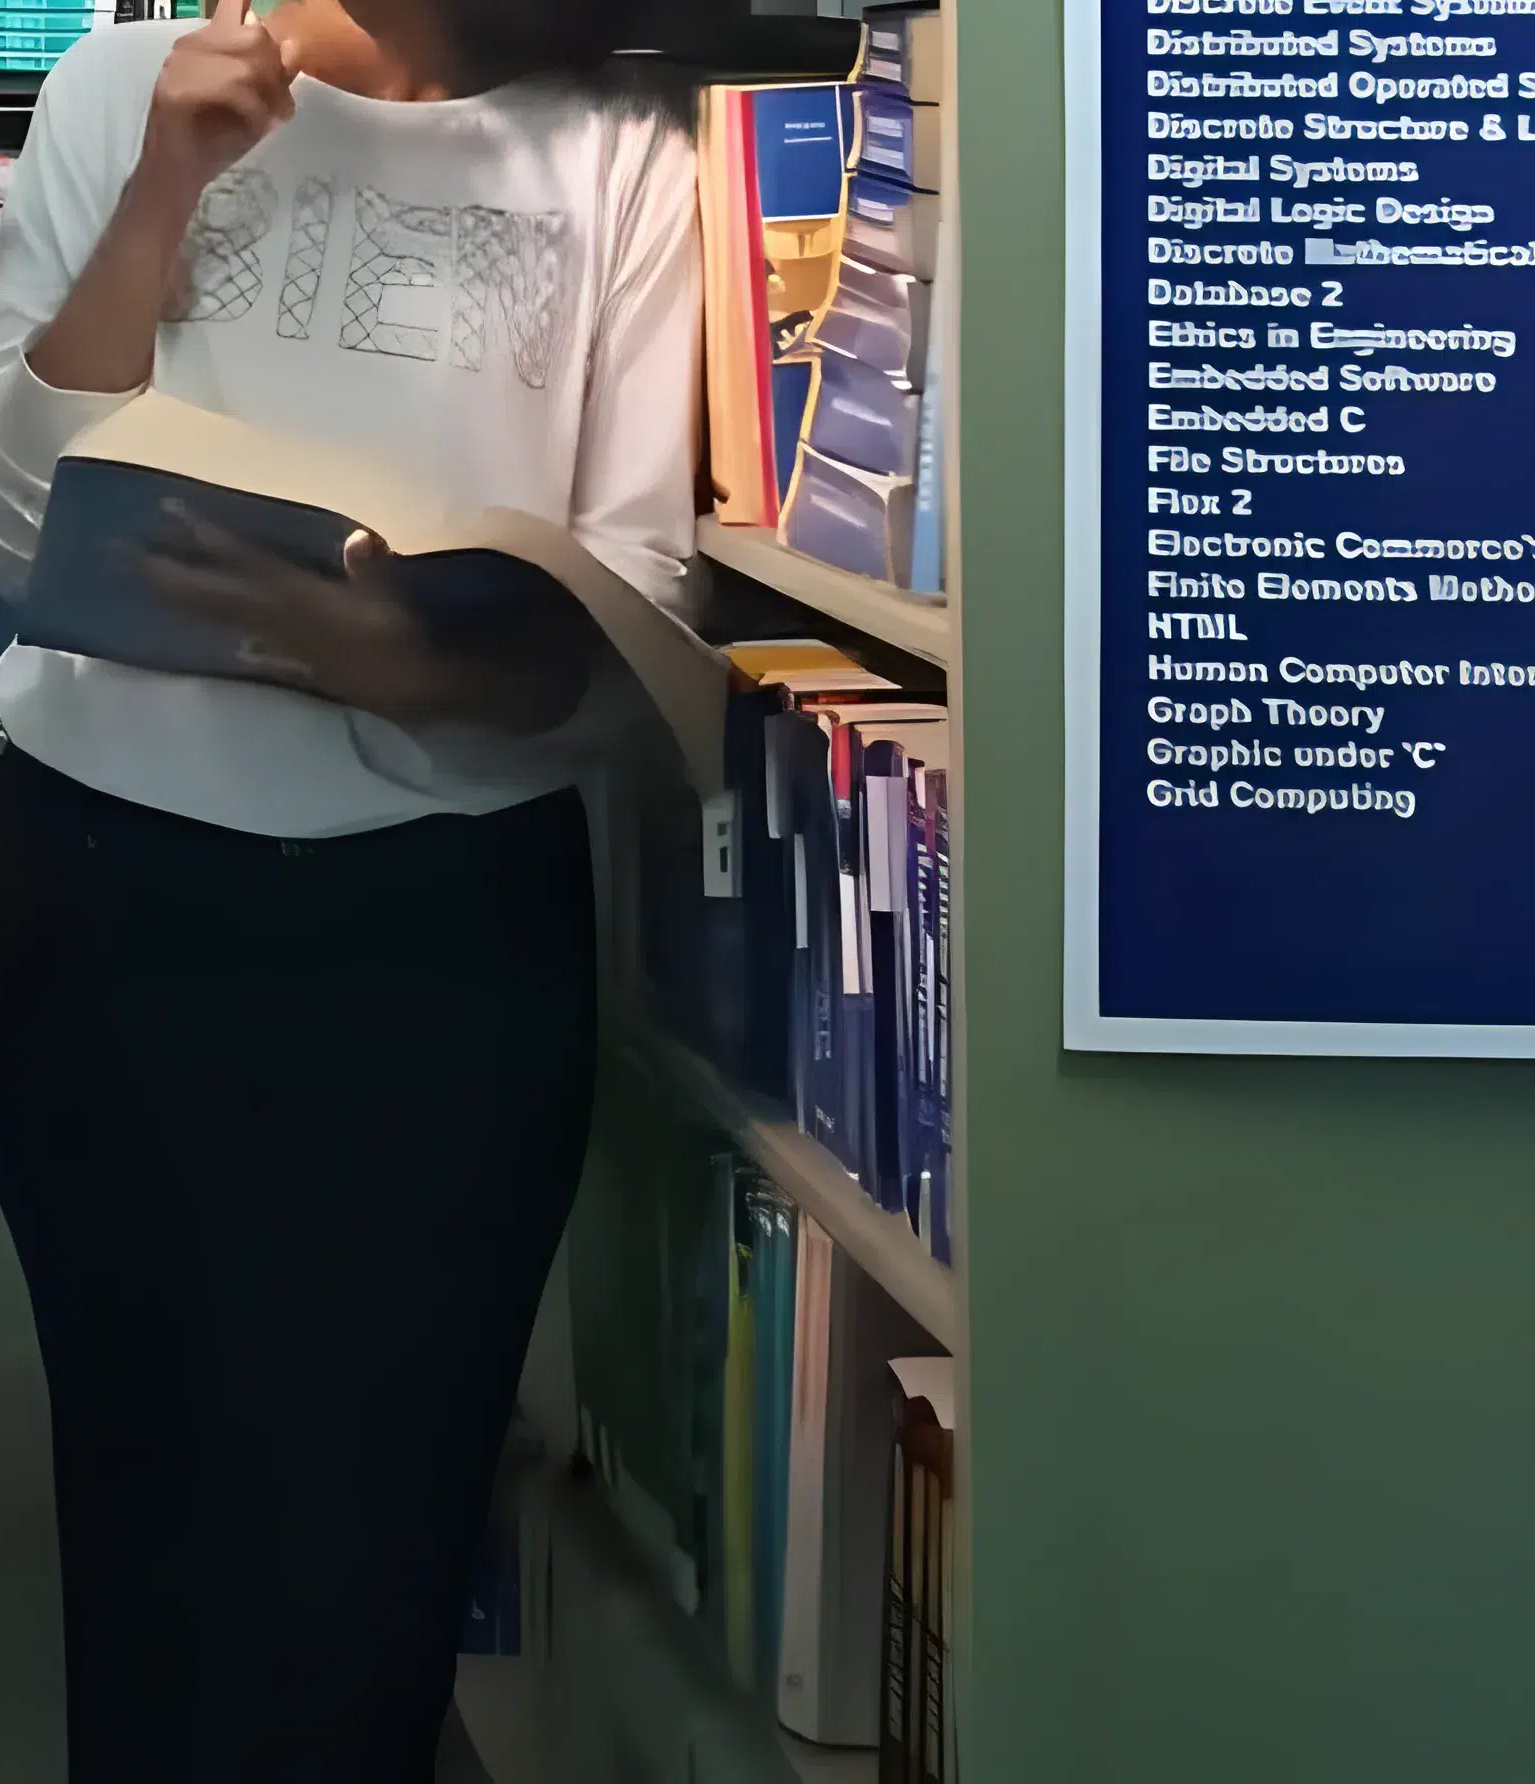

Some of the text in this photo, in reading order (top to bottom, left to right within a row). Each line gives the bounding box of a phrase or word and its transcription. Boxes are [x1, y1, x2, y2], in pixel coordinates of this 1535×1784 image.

[1146, 28, 1339, 57] Distributed
[1348, 27, 1498, 60] Systems
[1146, 69, 1339, 98] Distributed
[1147, 110, 1295, 140] Discrete
[1478, 113, 1508, 142] &
[1147, 153, 1261, 189] Digital
[1269, 153, 1420, 188] Systems
[1147, 194, 1261, 230] Digital
[1270, 195, 1366, 230] Logic
[1375, 195, 1496, 232] Design
[1147, 236, 1295, 266] Discrete
[1147, 277, 1344, 307] Database 2
[1148, 319, 1257, 349] Ethics
[1148, 361, 1330, 391] Embedded
[1338, 363, 1497, 393] Software
[1147, 403, 1367, 434] Embedded C
[1147, 444, 1406, 476] File Structures
[1230, 487, 1253, 515] 2
[1147, 528, 1326, 559] Electronic
[1147, 570, 1246, 599] Finite
[1257, 570, 1419, 602] Elements
[1148, 653, 1269, 682] Human
[1278, 656, 1451, 689] Computer
[1147, 695, 1253, 730] Graph
[1260, 696, 1386, 734] Theory
[1146, 737, 1282, 771] Graphic
[1293, 739, 1395, 768] under
[1146, 778, 1220, 808] Grid
[1229, 779, 1416, 819] Computing
